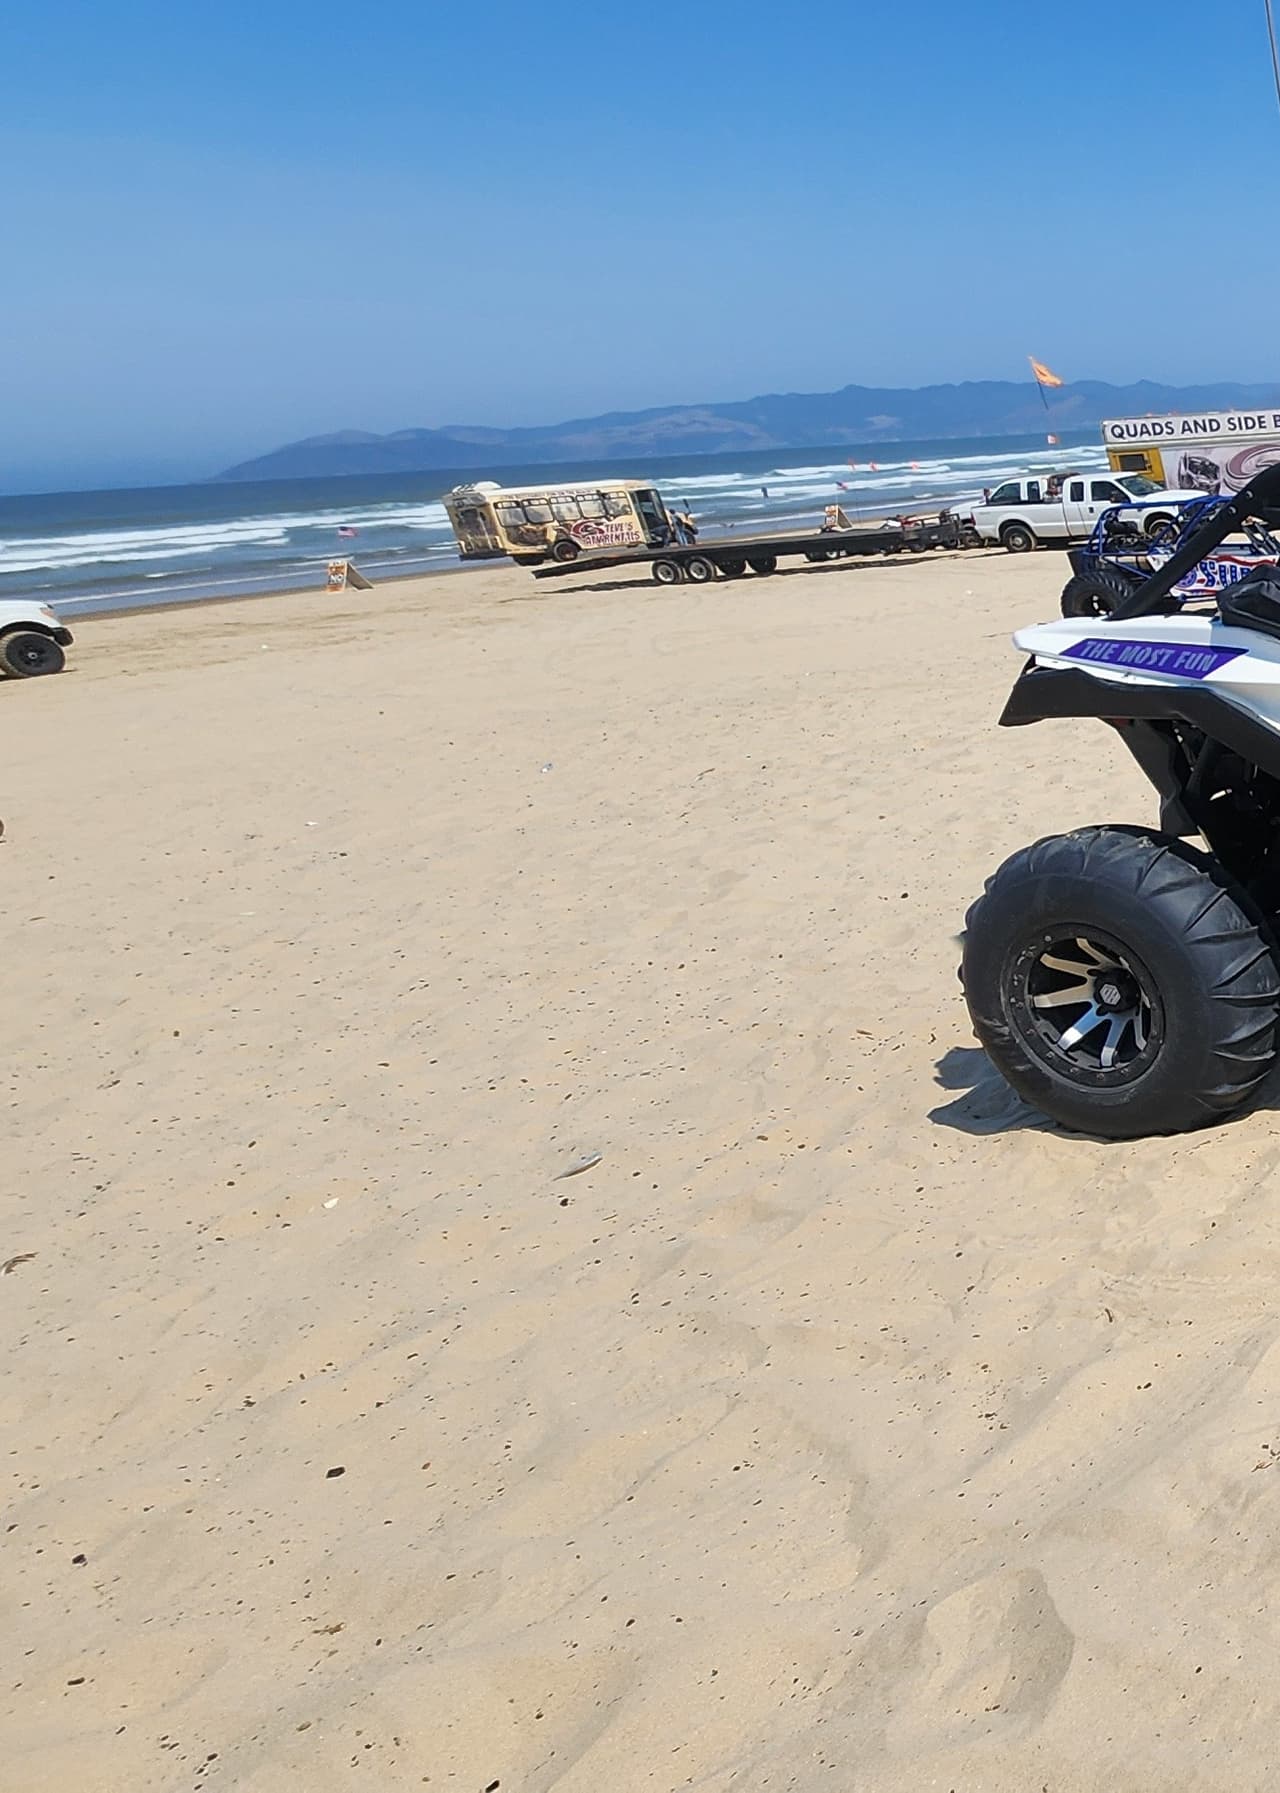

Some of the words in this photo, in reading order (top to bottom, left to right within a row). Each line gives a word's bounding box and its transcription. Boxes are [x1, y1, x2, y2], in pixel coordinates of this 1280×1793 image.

[1111, 421, 1175, 440] QUADS
[1181, 418, 1221, 435] AND
[1227, 415, 1267, 431] SIDE
[1079, 641, 1119, 660] THE
[1117, 645, 1174, 666] MOST
[1173, 651, 1217, 672] FUN
